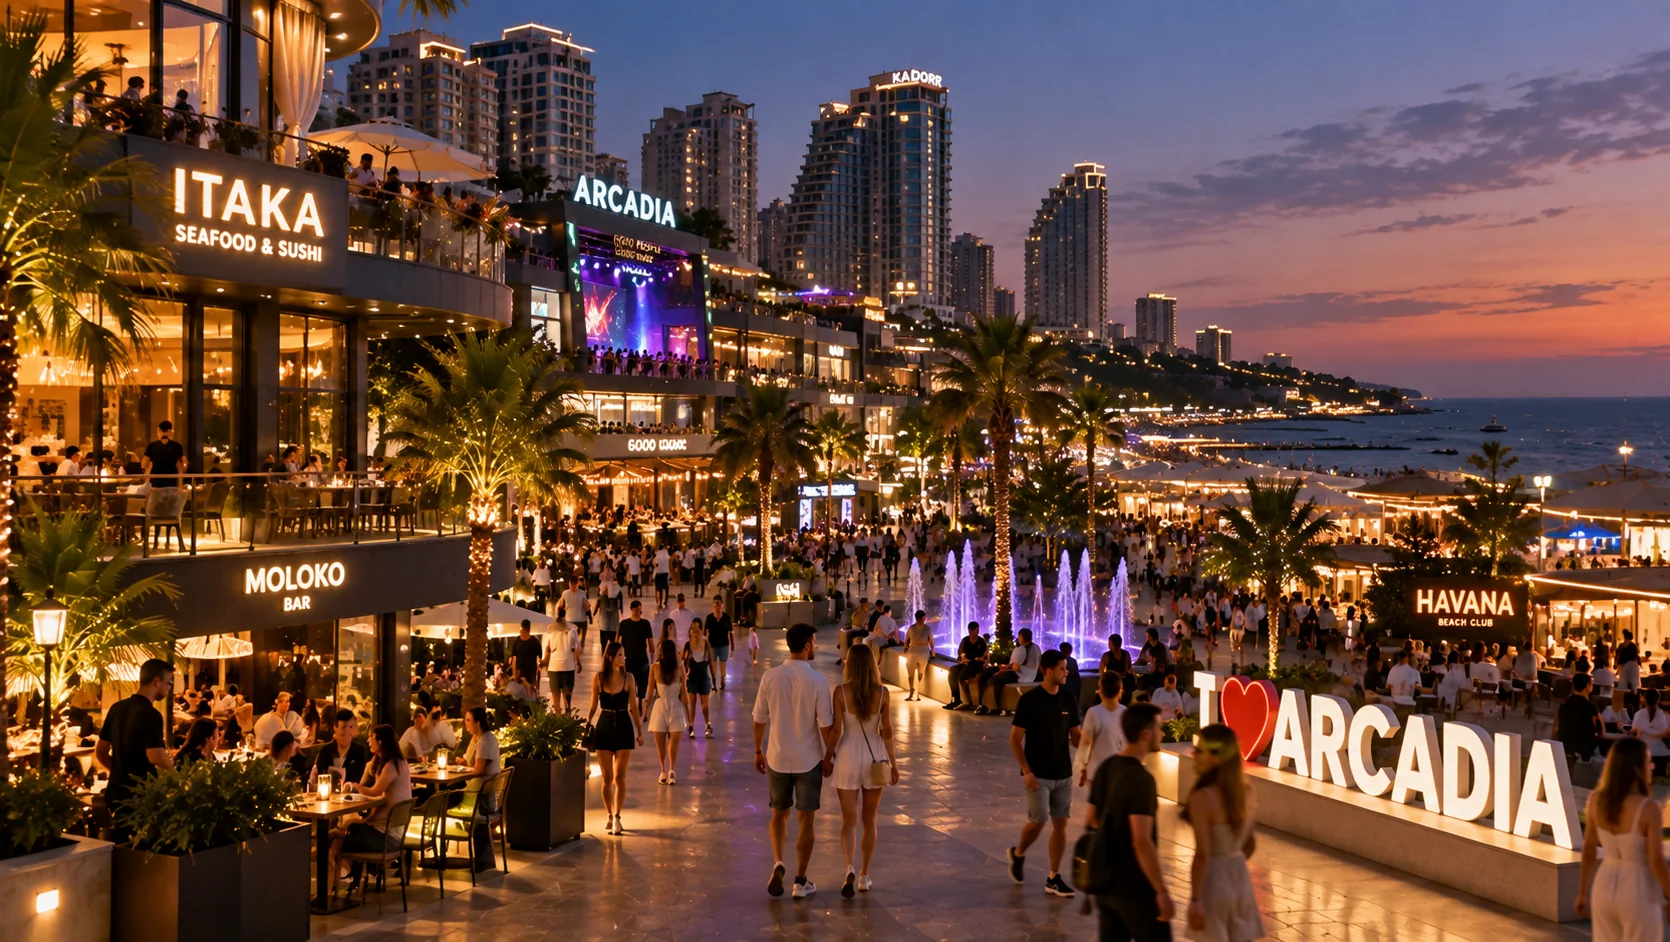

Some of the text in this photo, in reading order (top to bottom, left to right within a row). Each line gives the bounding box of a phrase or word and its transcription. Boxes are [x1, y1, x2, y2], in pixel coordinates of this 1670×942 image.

[892, 69, 943, 88] KADORR
[174, 168, 325, 237] ITAKA
[573, 174, 676, 229] ARCADIA
[175, 223, 324, 263] SEAFOOD & SUSHI
[245, 561, 346, 595] MOLOKO
[283, 595, 311, 612] BAR
[1416, 588, 1515, 616] HAVANA
[1438, 617, 1494, 628] BEACH CLUB
[1267, 687, 1583, 852] ARCADIA
